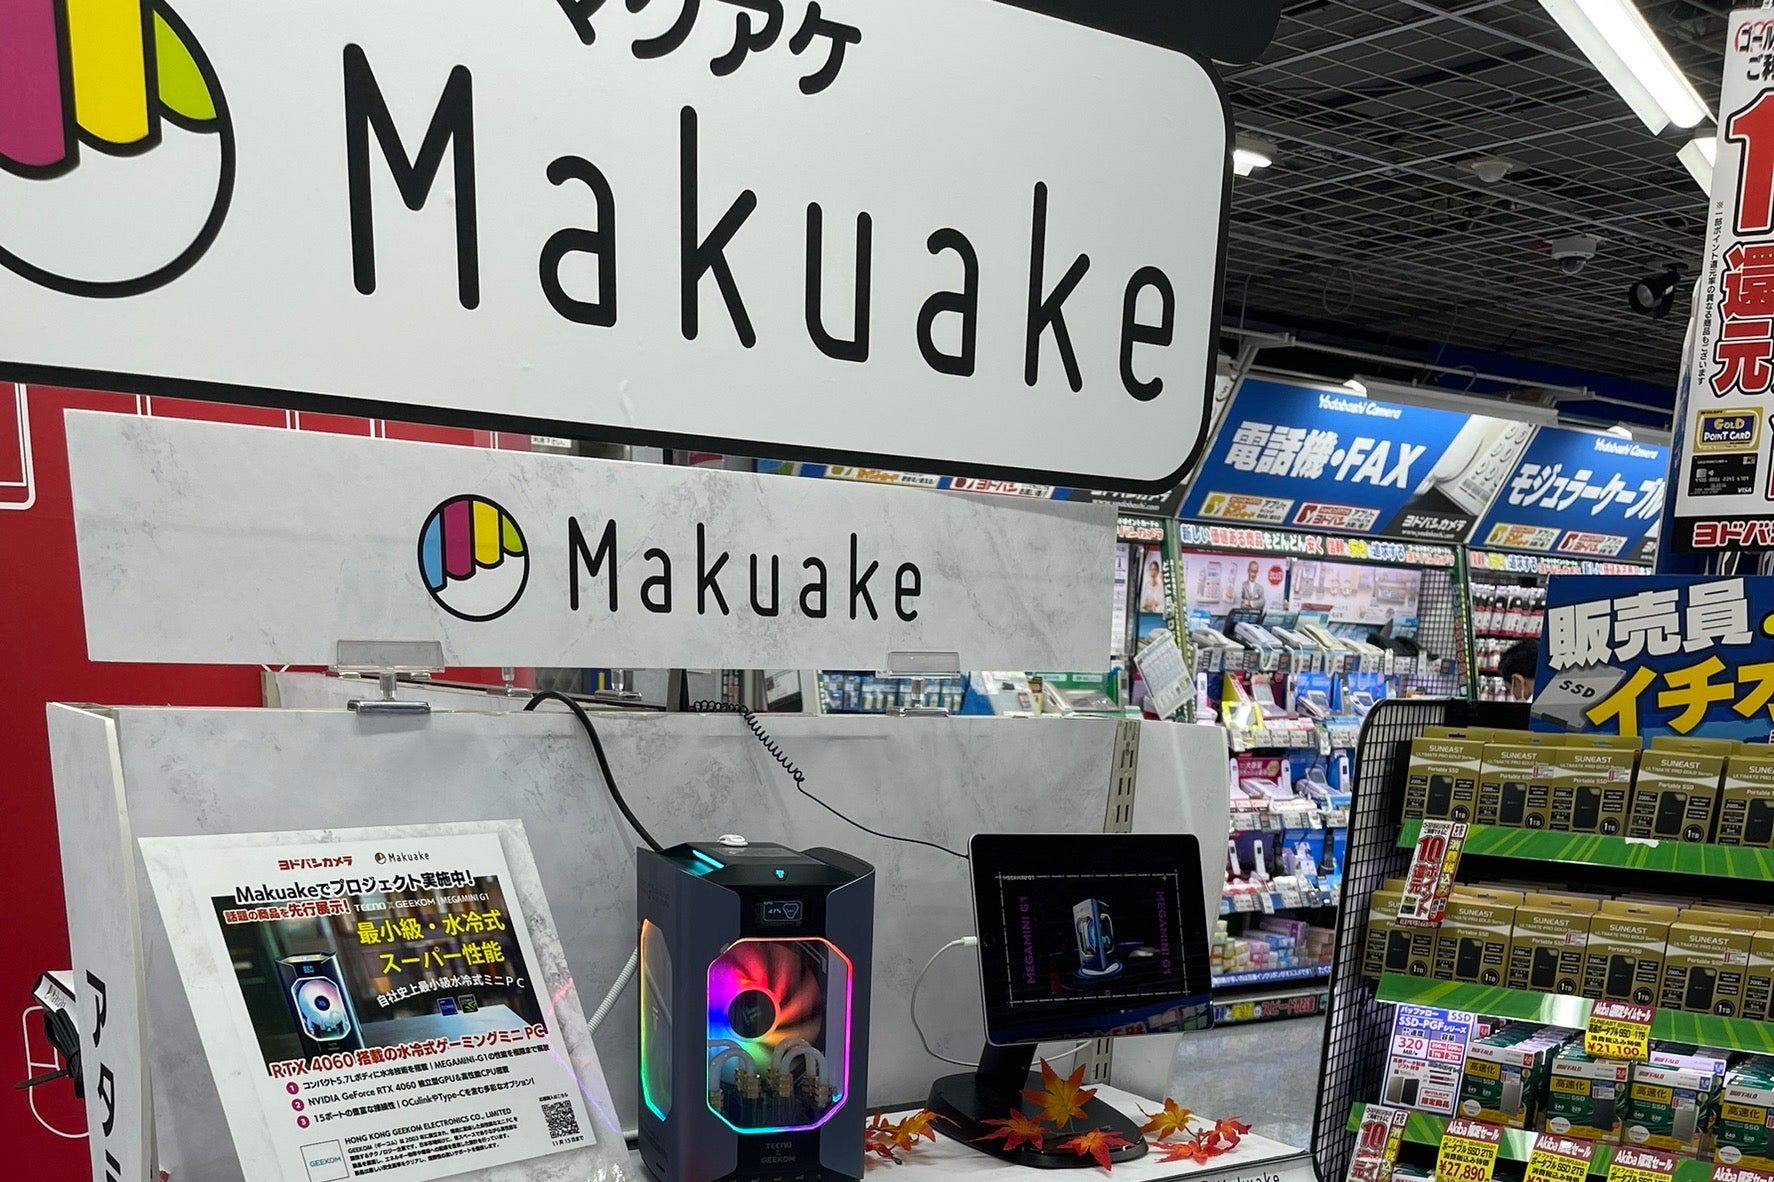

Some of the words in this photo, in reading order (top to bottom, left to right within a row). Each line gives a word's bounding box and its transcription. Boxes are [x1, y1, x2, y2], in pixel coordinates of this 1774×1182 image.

[343, 43, 1175, 402] Makuake
[1704, 431, 1727, 442] POINT
[1729, 430, 1751, 441] CARD
[1224, 421, 1427, 489] 電話機・FAX
[1508, 463, 1666, 520] モジュラーケーブル
[1402, 514, 1467, 532] ヨドバシカメラ
[568, 517, 921, 622] Makuake
[1548, 578, 1753, 671] 販売員
[1559, 680, 1596, 698] SSD
[1429, 745, 1464, 753] SUNEAST
[1501, 752, 1537, 760] SUNEAST
[1574, 755, 1612, 763] SUNEAST
[1661, 759, 1700, 769] SUNEAST
[278, 856, 353, 871] ヨドバシカメラ
[388, 851, 430, 863] Makuake
[1459, 908, 1493, 917] SUNEAST
[357, 910, 505, 946] 最小級・水冷式
[1157, 890, 1169, 957] MEGAMINI
[1533, 917, 1570, 926] SUNEAST
[1610, 924, 1648, 934] SUNEAST
[1689, 935, 1729, 945] SUNEAST
[1021, 915, 1037, 985] MEGAMINI
[380, 941, 505, 975] スーパー性能
[1400, 1006, 1439, 1017] バッファロー
[1451, 1011, 1472, 1022] SSD
[1398, 1036, 1424, 1051] 320
[271, 1060, 308, 1079] RTX
[312, 1053, 354, 1073] 4060
[525, 1024, 547, 1039] PC
[1470, 1063, 1496, 1074] 高速化
[1555, 1079, 1585, 1091] 高速化
[1636, 1086, 1667, 1099] 高速化
[308, 1093, 340, 1106] NVIDIA
[341, 1088, 375, 1101] GeForce
[376, 1084, 394, 1095] RTX
[395, 1081, 417, 1092] 4060
[1727, 1106, 1760, 1119] 高速化
[345, 1136, 368, 1145] HONG
[369, 1130, 391, 1141] KONG
[392, 1124, 422, 1137] GEEKOM
[423, 1115, 469, 1131] ELECTRONICS
[486, 1107, 512, 1119] LIMITED
[1447, 1121, 1467, 1136] Akiba
[1536, 1135, 1558, 1150] Akiba
[1615, 1150, 1637, 1166] Akiba
[1713, 1167, 1737, 1182] Akiba
